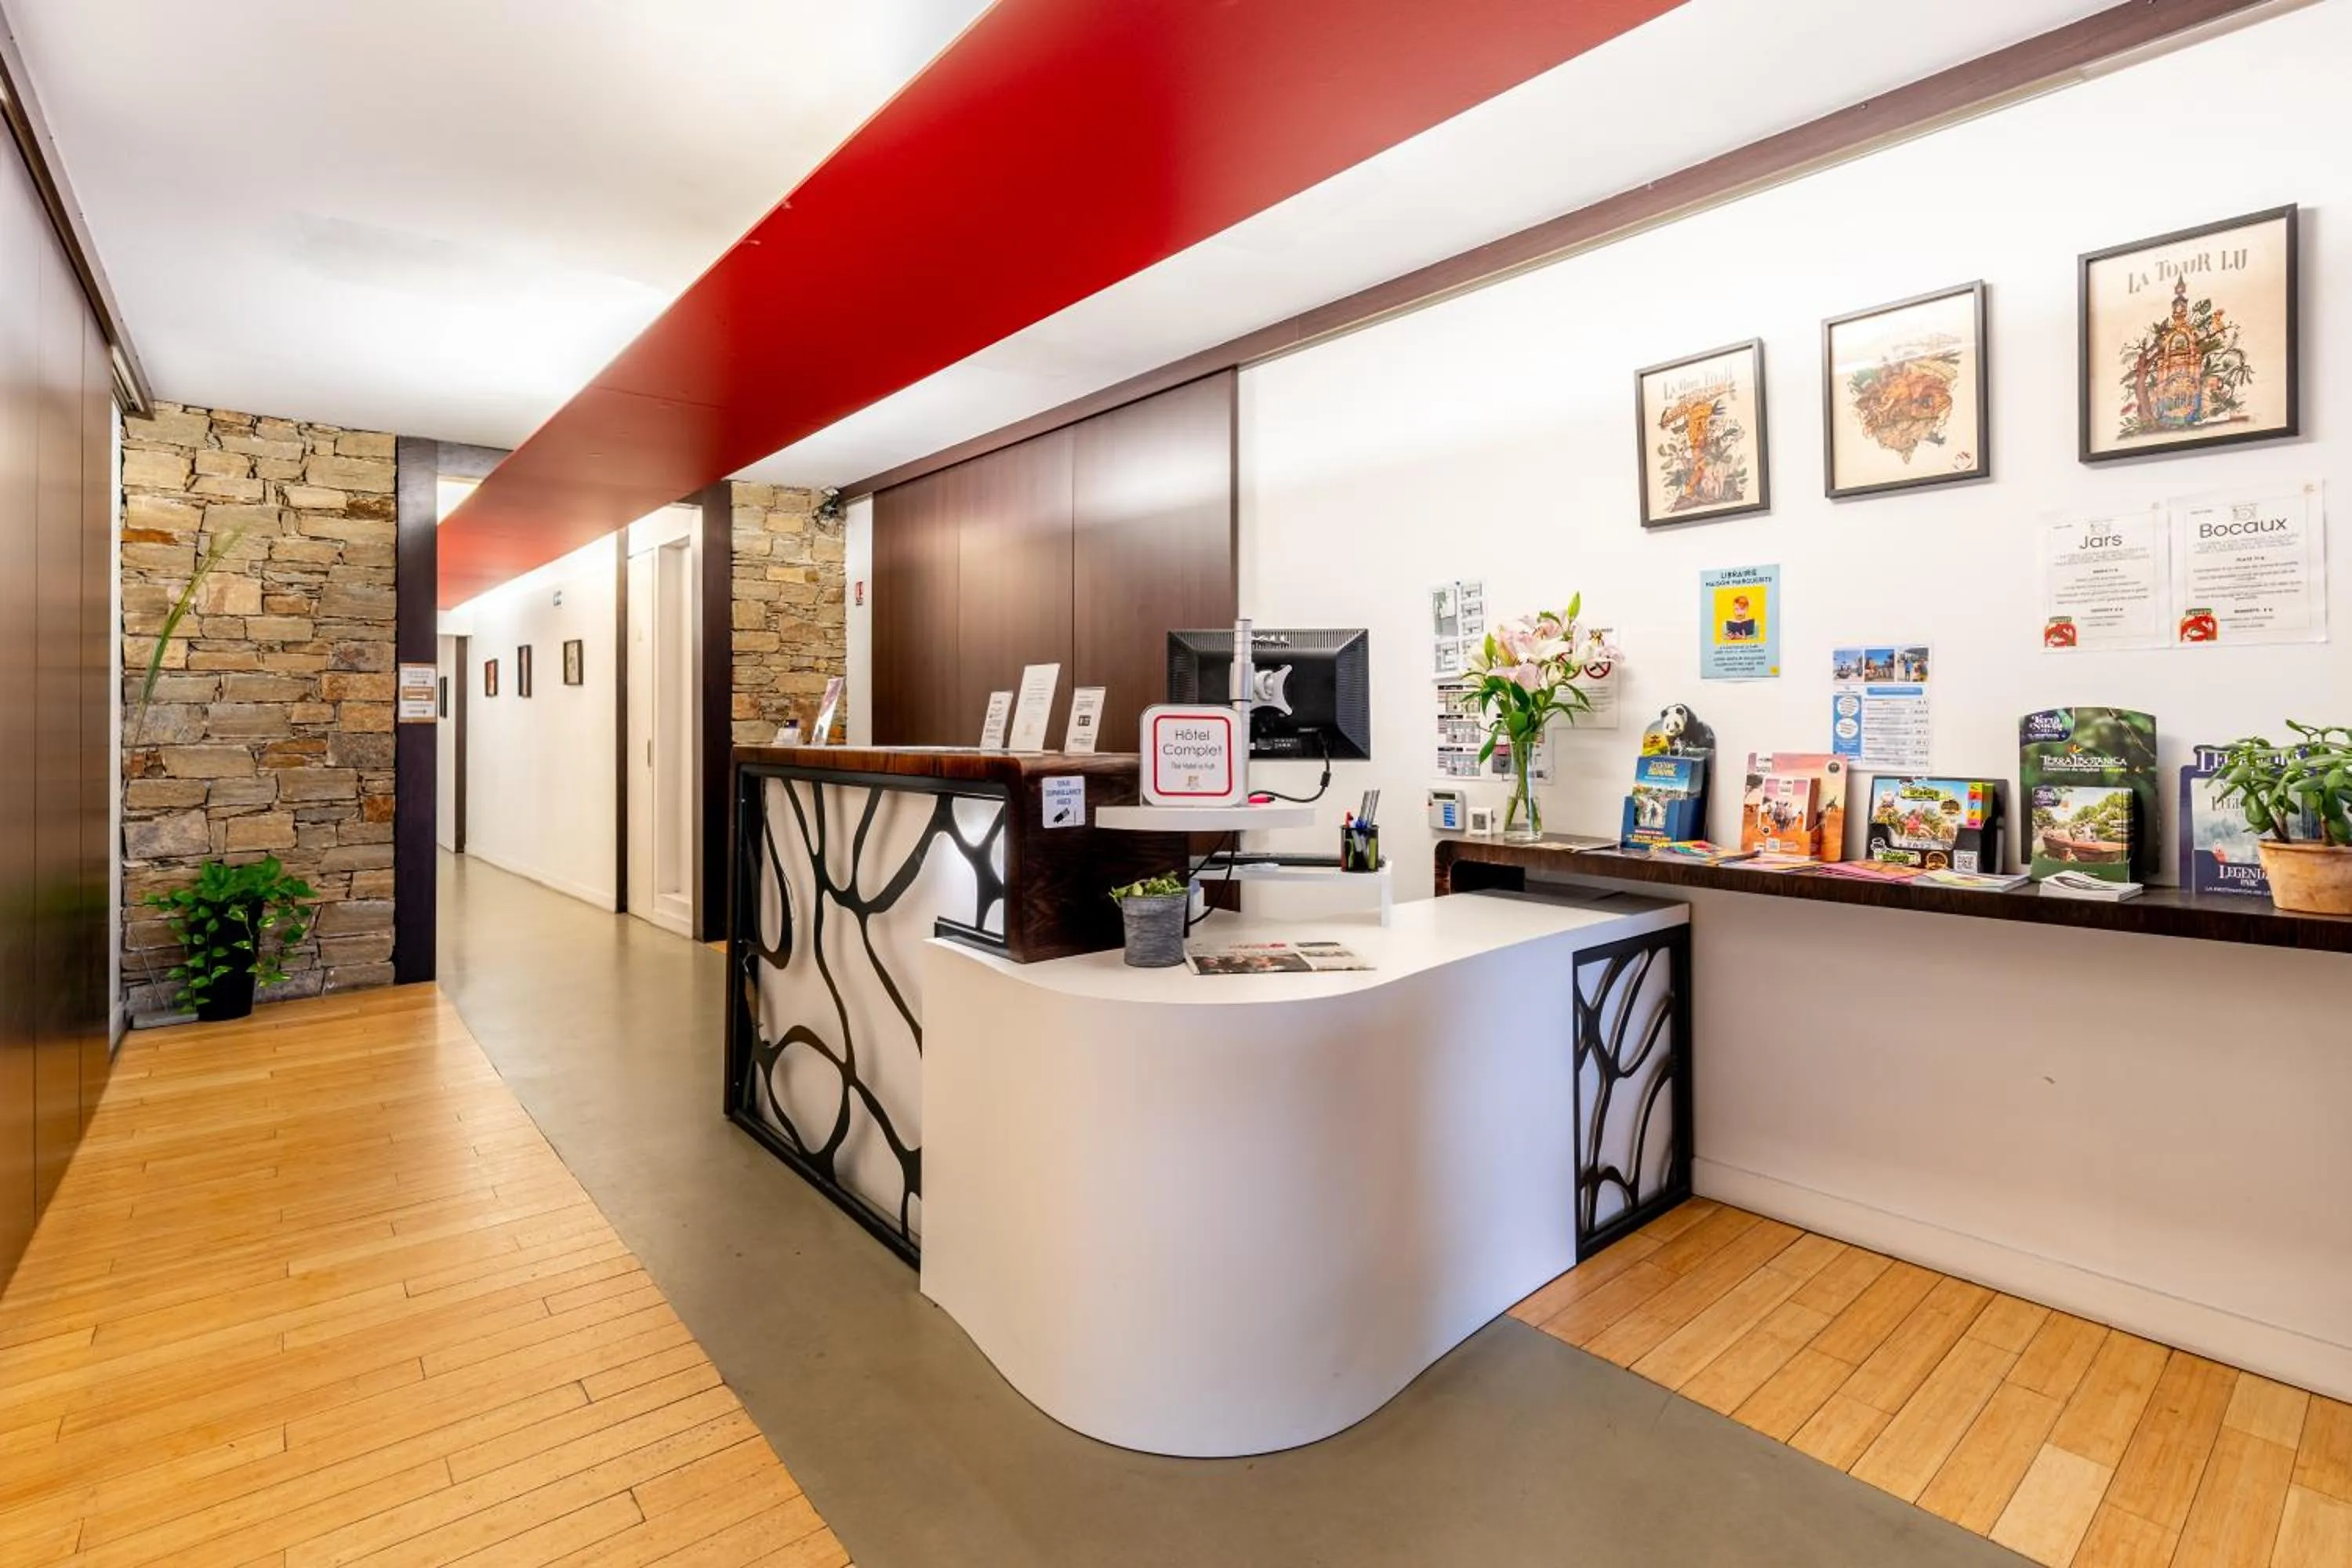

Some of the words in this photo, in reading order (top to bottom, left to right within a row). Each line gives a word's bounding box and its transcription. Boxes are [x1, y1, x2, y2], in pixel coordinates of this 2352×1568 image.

[2128, 272, 2150, 294] LA
[2156, 252, 2212, 281] TOUR
[2221, 248, 2248, 270] LU
[2199, 517, 2287, 539] Bocaux
[2078, 533, 2123, 550] Jars
[1175, 728, 1210, 741] Hôtel
[1163, 743, 1222, 757] Complet
[2220, 865, 2267, 879] LEGEND
